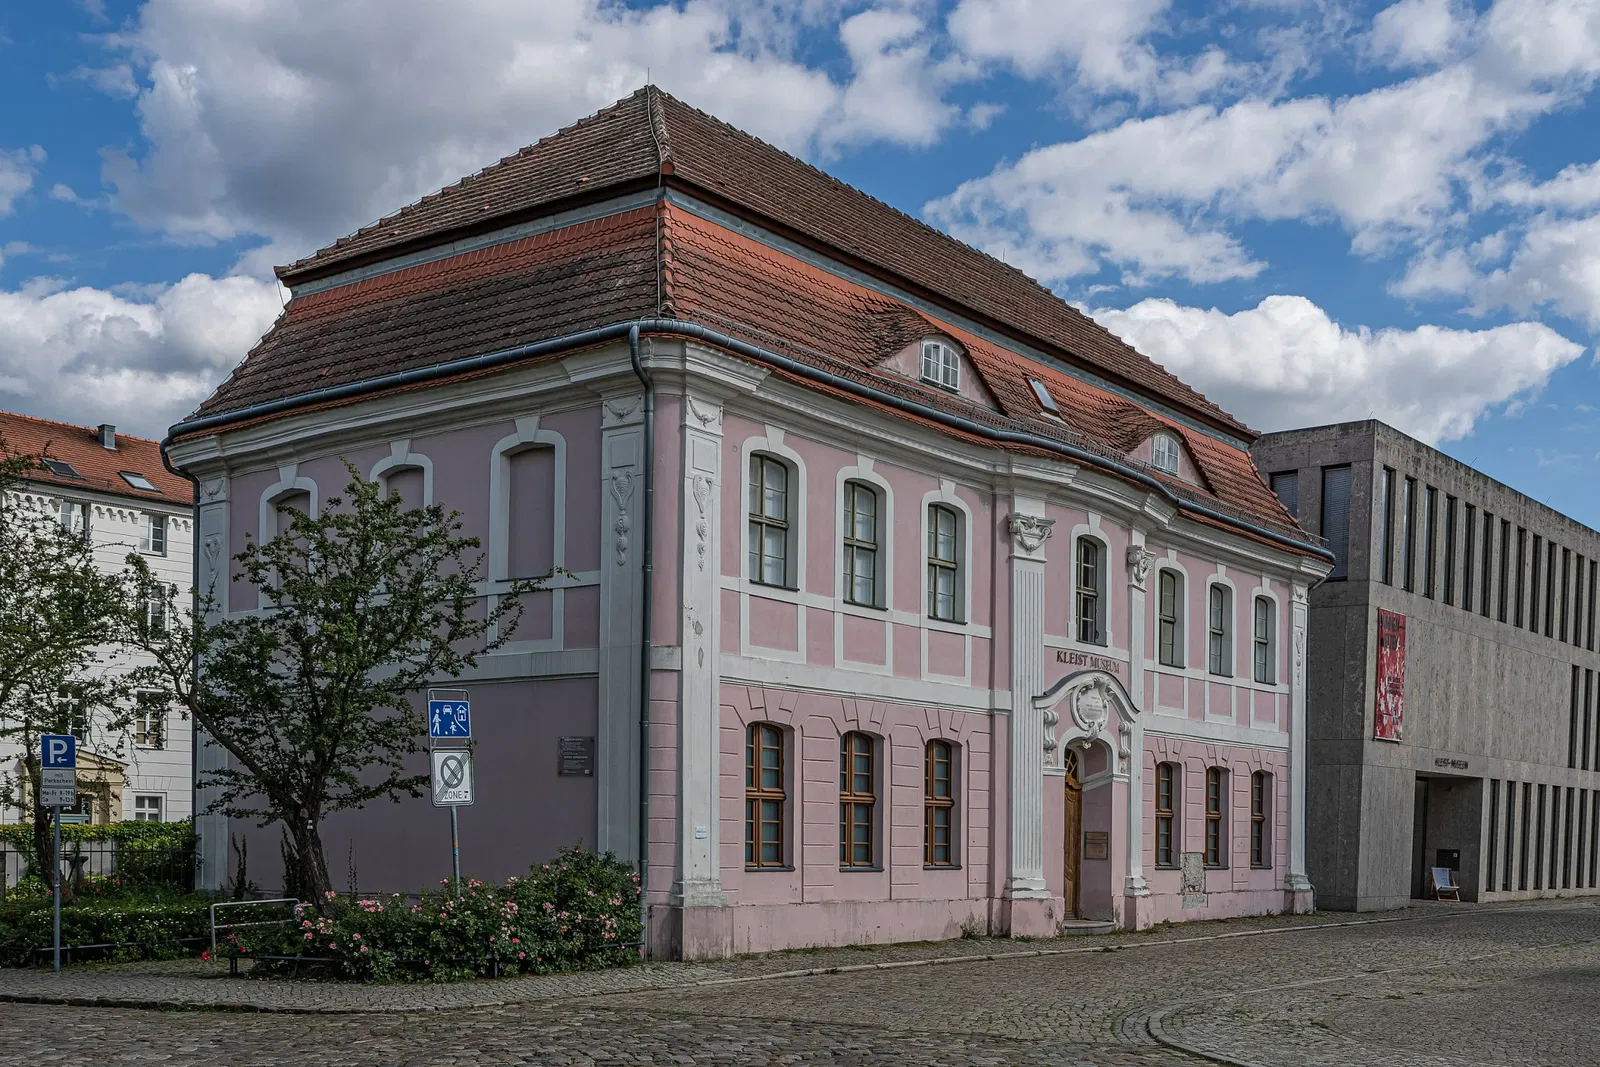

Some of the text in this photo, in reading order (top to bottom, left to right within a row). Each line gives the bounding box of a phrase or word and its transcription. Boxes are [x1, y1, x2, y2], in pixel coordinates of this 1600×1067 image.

[1056, 650, 1120, 674] KLEIST MUSEUM
[49, 739, 68, 764] P
[444, 790, 462, 800] ZONE
